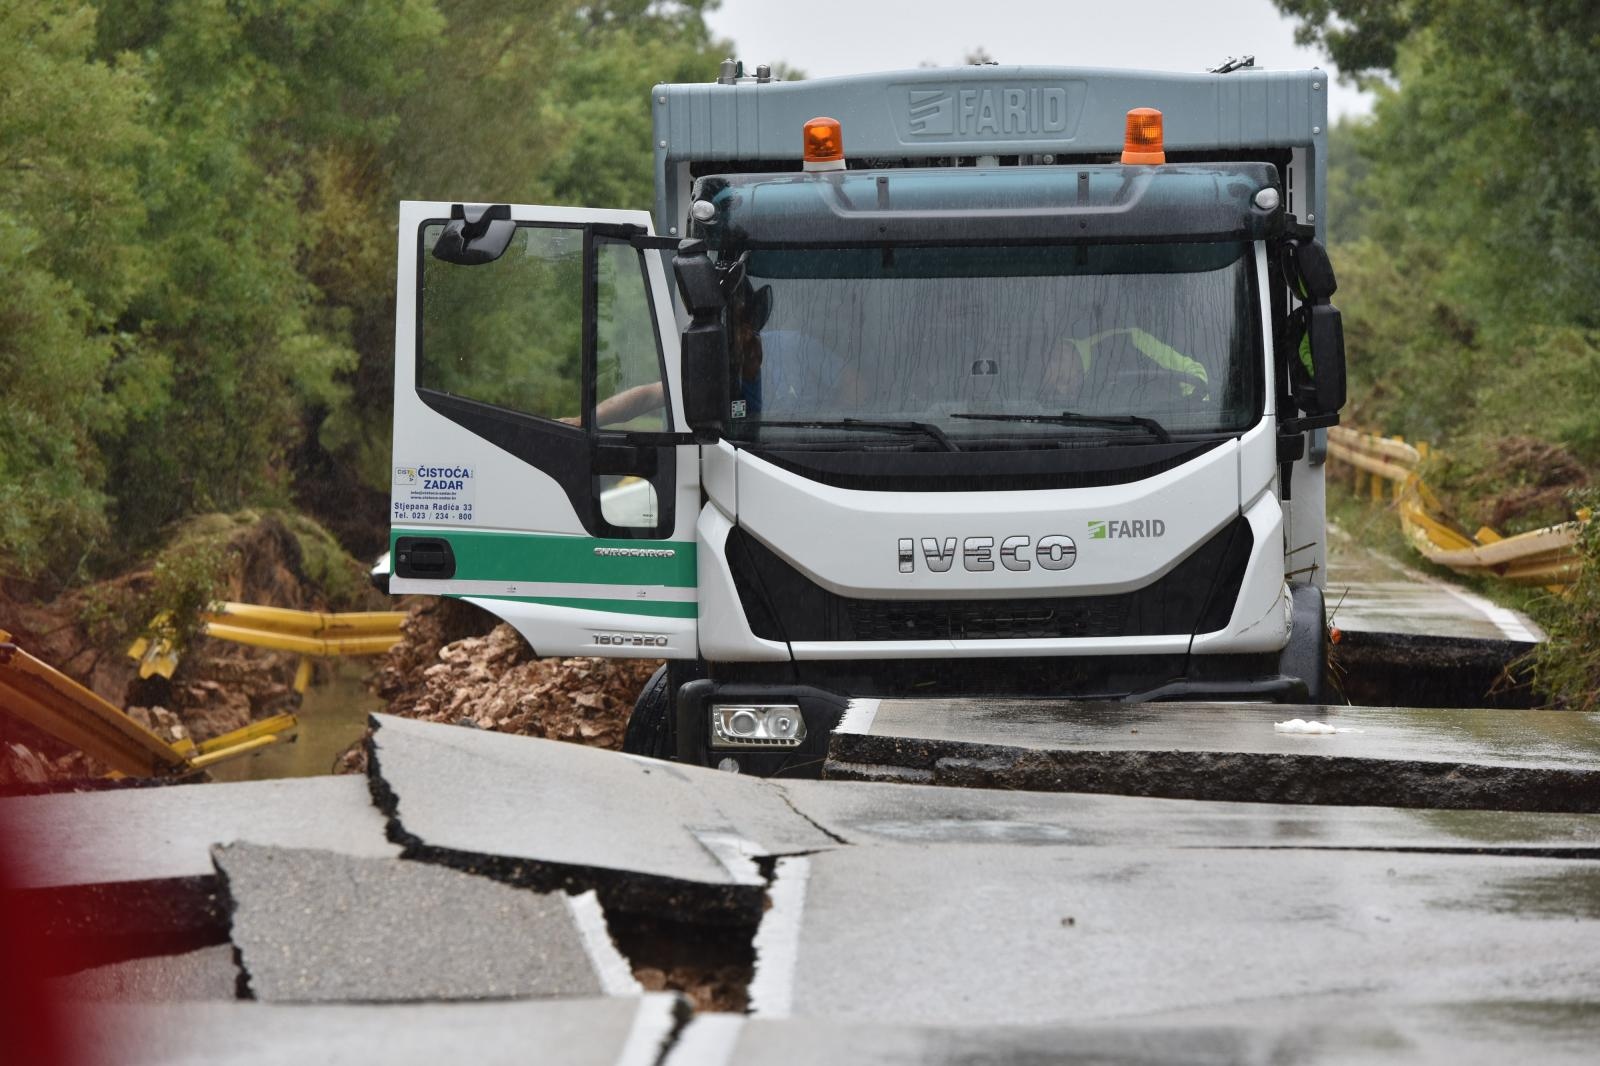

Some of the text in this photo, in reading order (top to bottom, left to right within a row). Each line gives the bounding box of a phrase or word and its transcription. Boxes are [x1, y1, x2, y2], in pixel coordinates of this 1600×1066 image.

[959, 87, 1068, 135] FARID
[418, 465, 469, 478] ČISTOĆA
[424, 479, 463, 490] ZADAR
[394, 502, 429, 511] Stjepana
[432, 503, 460, 511] Radića
[412, 512, 426, 520] 023
[458, 513, 472, 521] 800
[1108, 519, 1166, 539] FARID
[594, 547, 675, 558] EUROCARGO
[898, 534, 1077, 573] IVECO
[592, 634, 668, 647] 180-320
